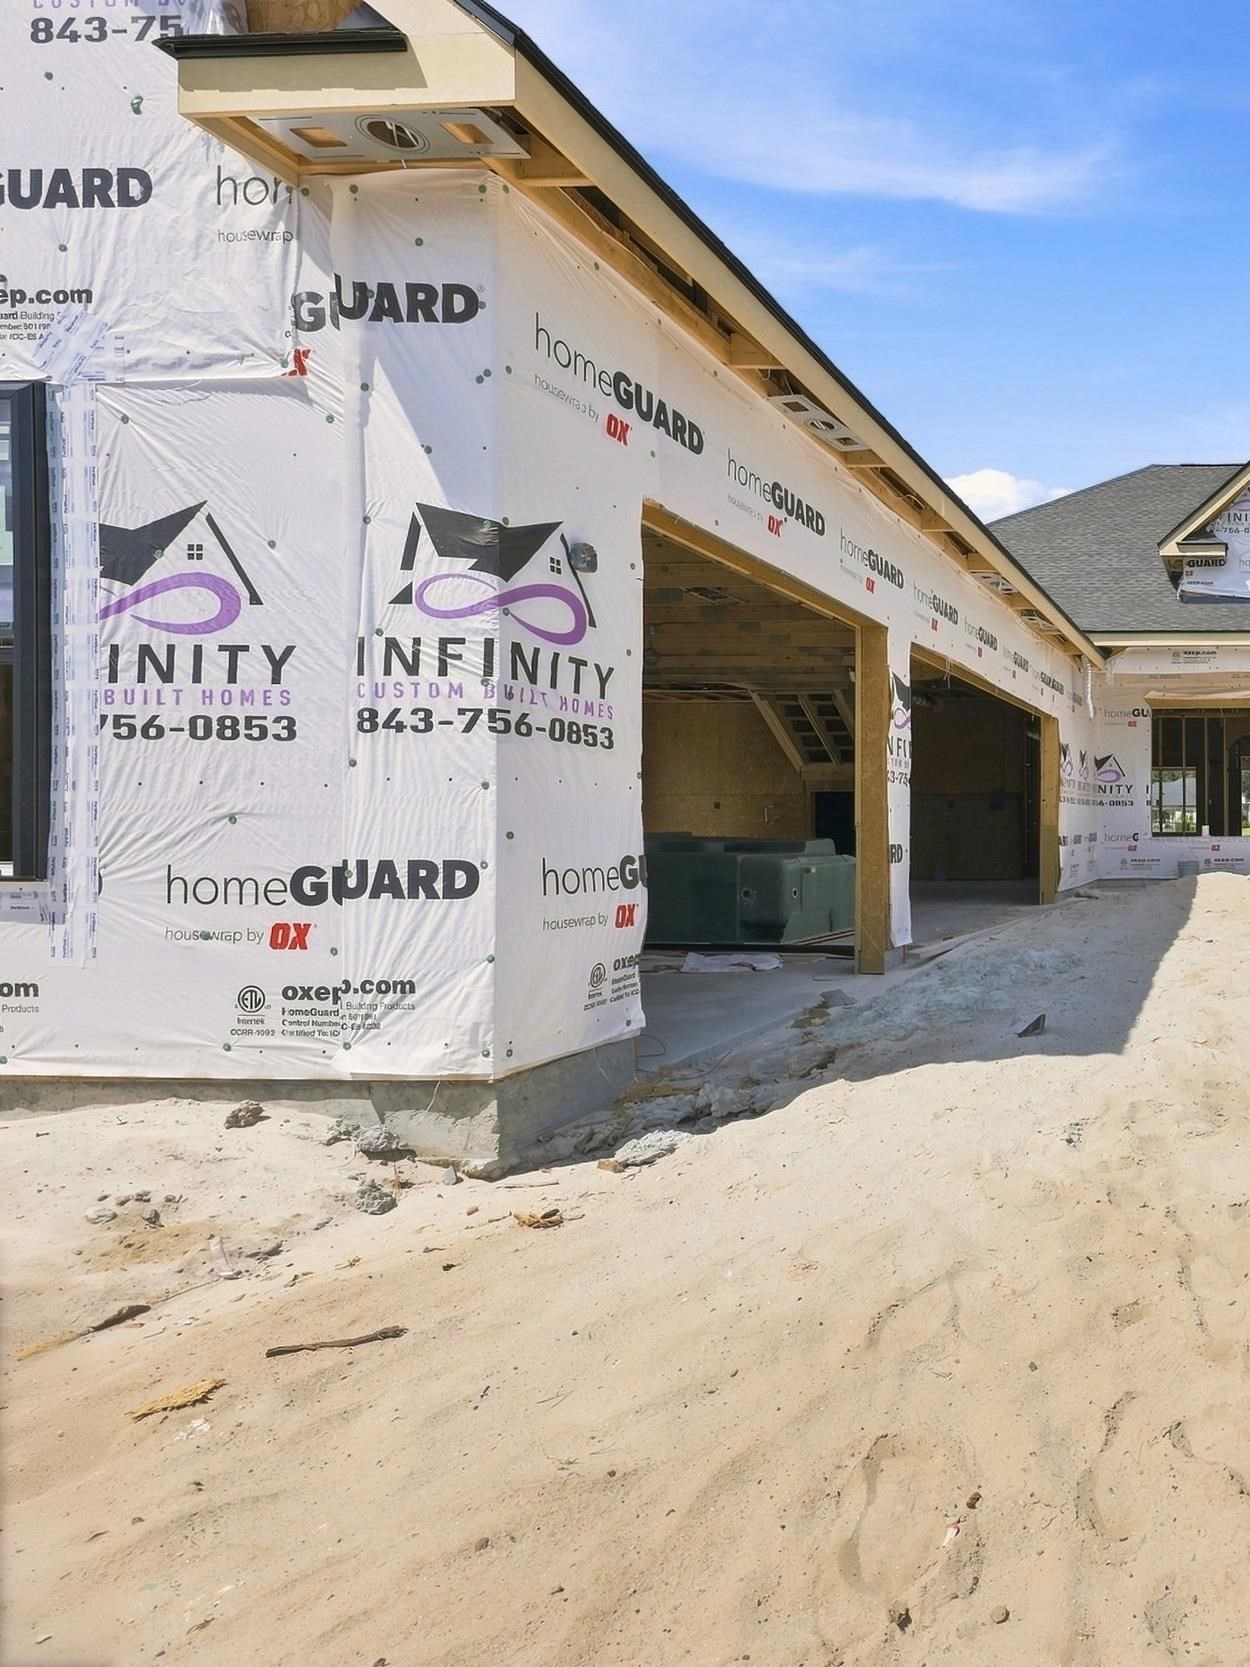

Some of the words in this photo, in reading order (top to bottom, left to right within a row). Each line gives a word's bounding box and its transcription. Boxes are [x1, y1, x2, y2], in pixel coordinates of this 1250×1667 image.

[0, 168, 152, 209] UARD
[217, 228, 294, 245] housewrap
[535, 311, 705, 456] homeGUARD
[606, 413, 630, 447] OX
[727, 447, 826, 537] homeGUARD
[767, 514, 783, 538] OX
[840, 527, 904, 589] homeGUARD
[356, 636, 615, 700] INFINITY
[104, 689, 184, 706] BUILT
[201, 689, 292, 706] HOMES
[357, 681, 464, 699] CUSTOM
[559, 695, 614, 720] HOMES
[356, 706, 615, 750] 843-756-0853
[166, 858, 481, 907] homeGUARD
[542, 915, 596, 931] housewrap
[597, 912, 609, 927] by
[614, 903, 636, 929] OX
[246, 928, 264, 945] by
[269, 922, 312, 950] OX
[1, 1004, 39, 1013] Products
[281, 978, 417, 1005] oxep.com
